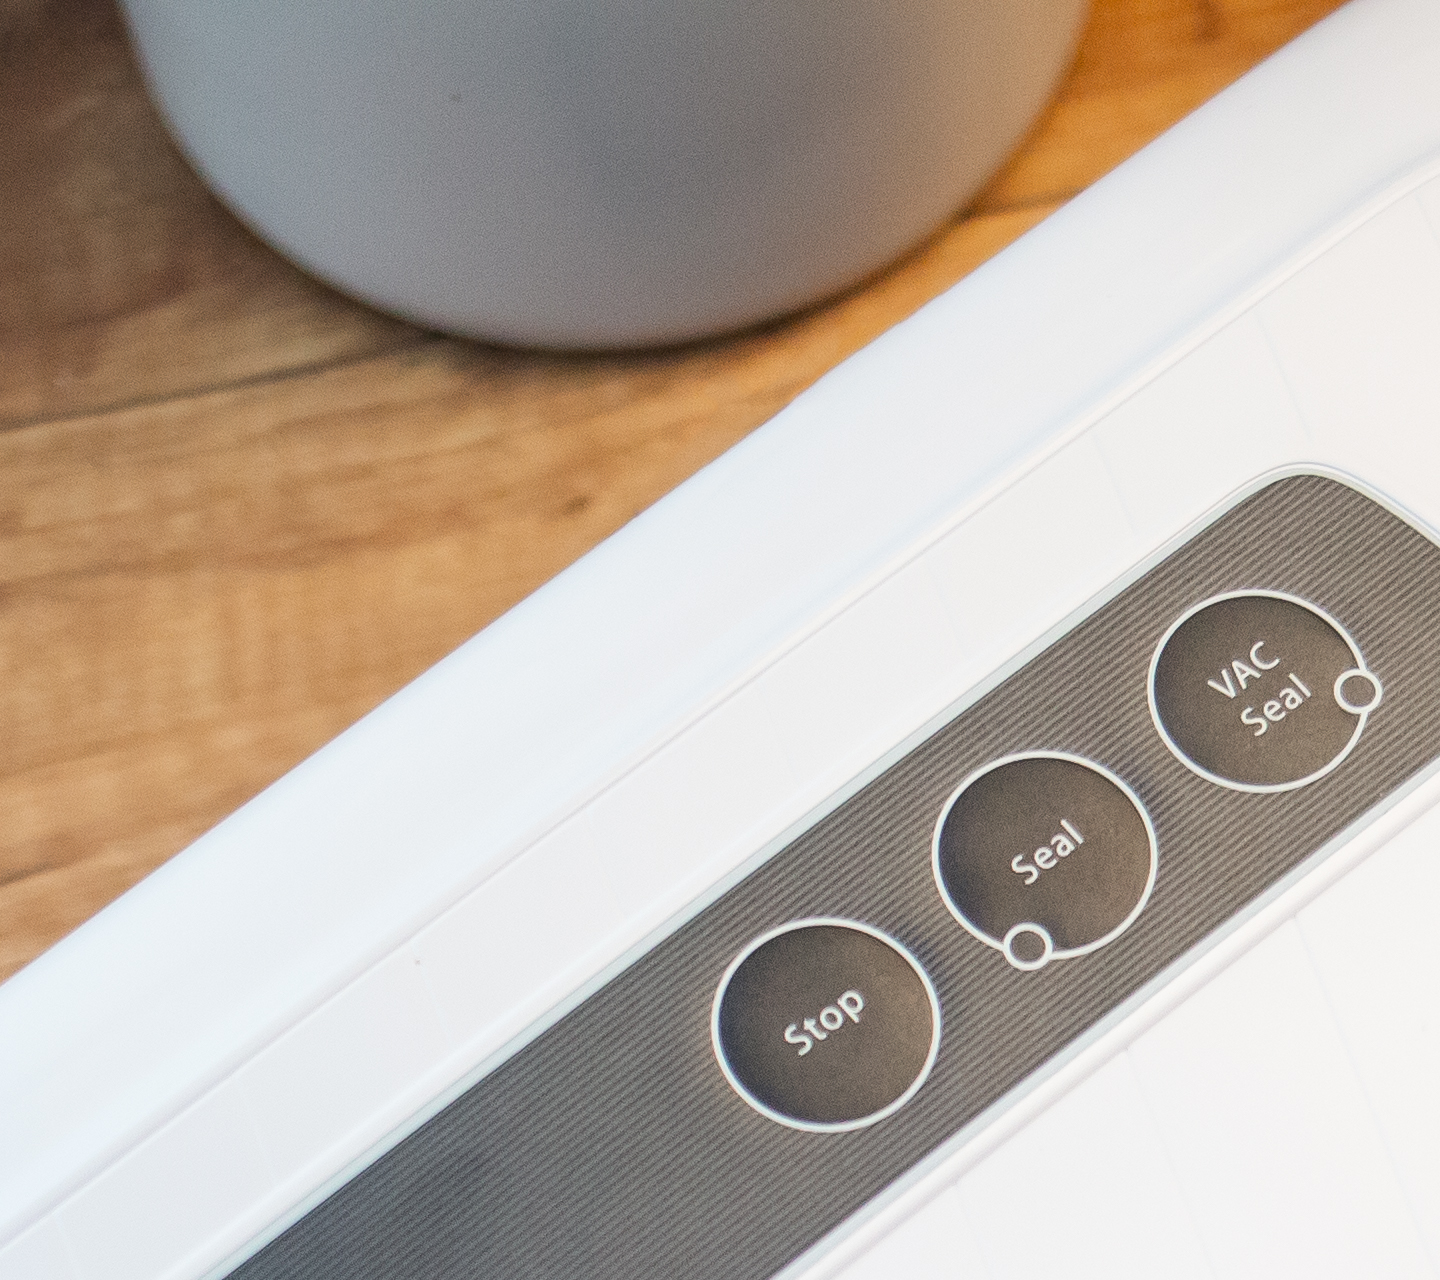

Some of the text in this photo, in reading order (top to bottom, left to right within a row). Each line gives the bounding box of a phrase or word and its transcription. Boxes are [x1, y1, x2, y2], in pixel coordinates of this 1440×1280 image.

[1206, 641, 1281, 700] VAC
[1240, 674, 1312, 737] Seal
[1011, 819, 1085, 885] Seal
[783, 989, 864, 1056] Stop
